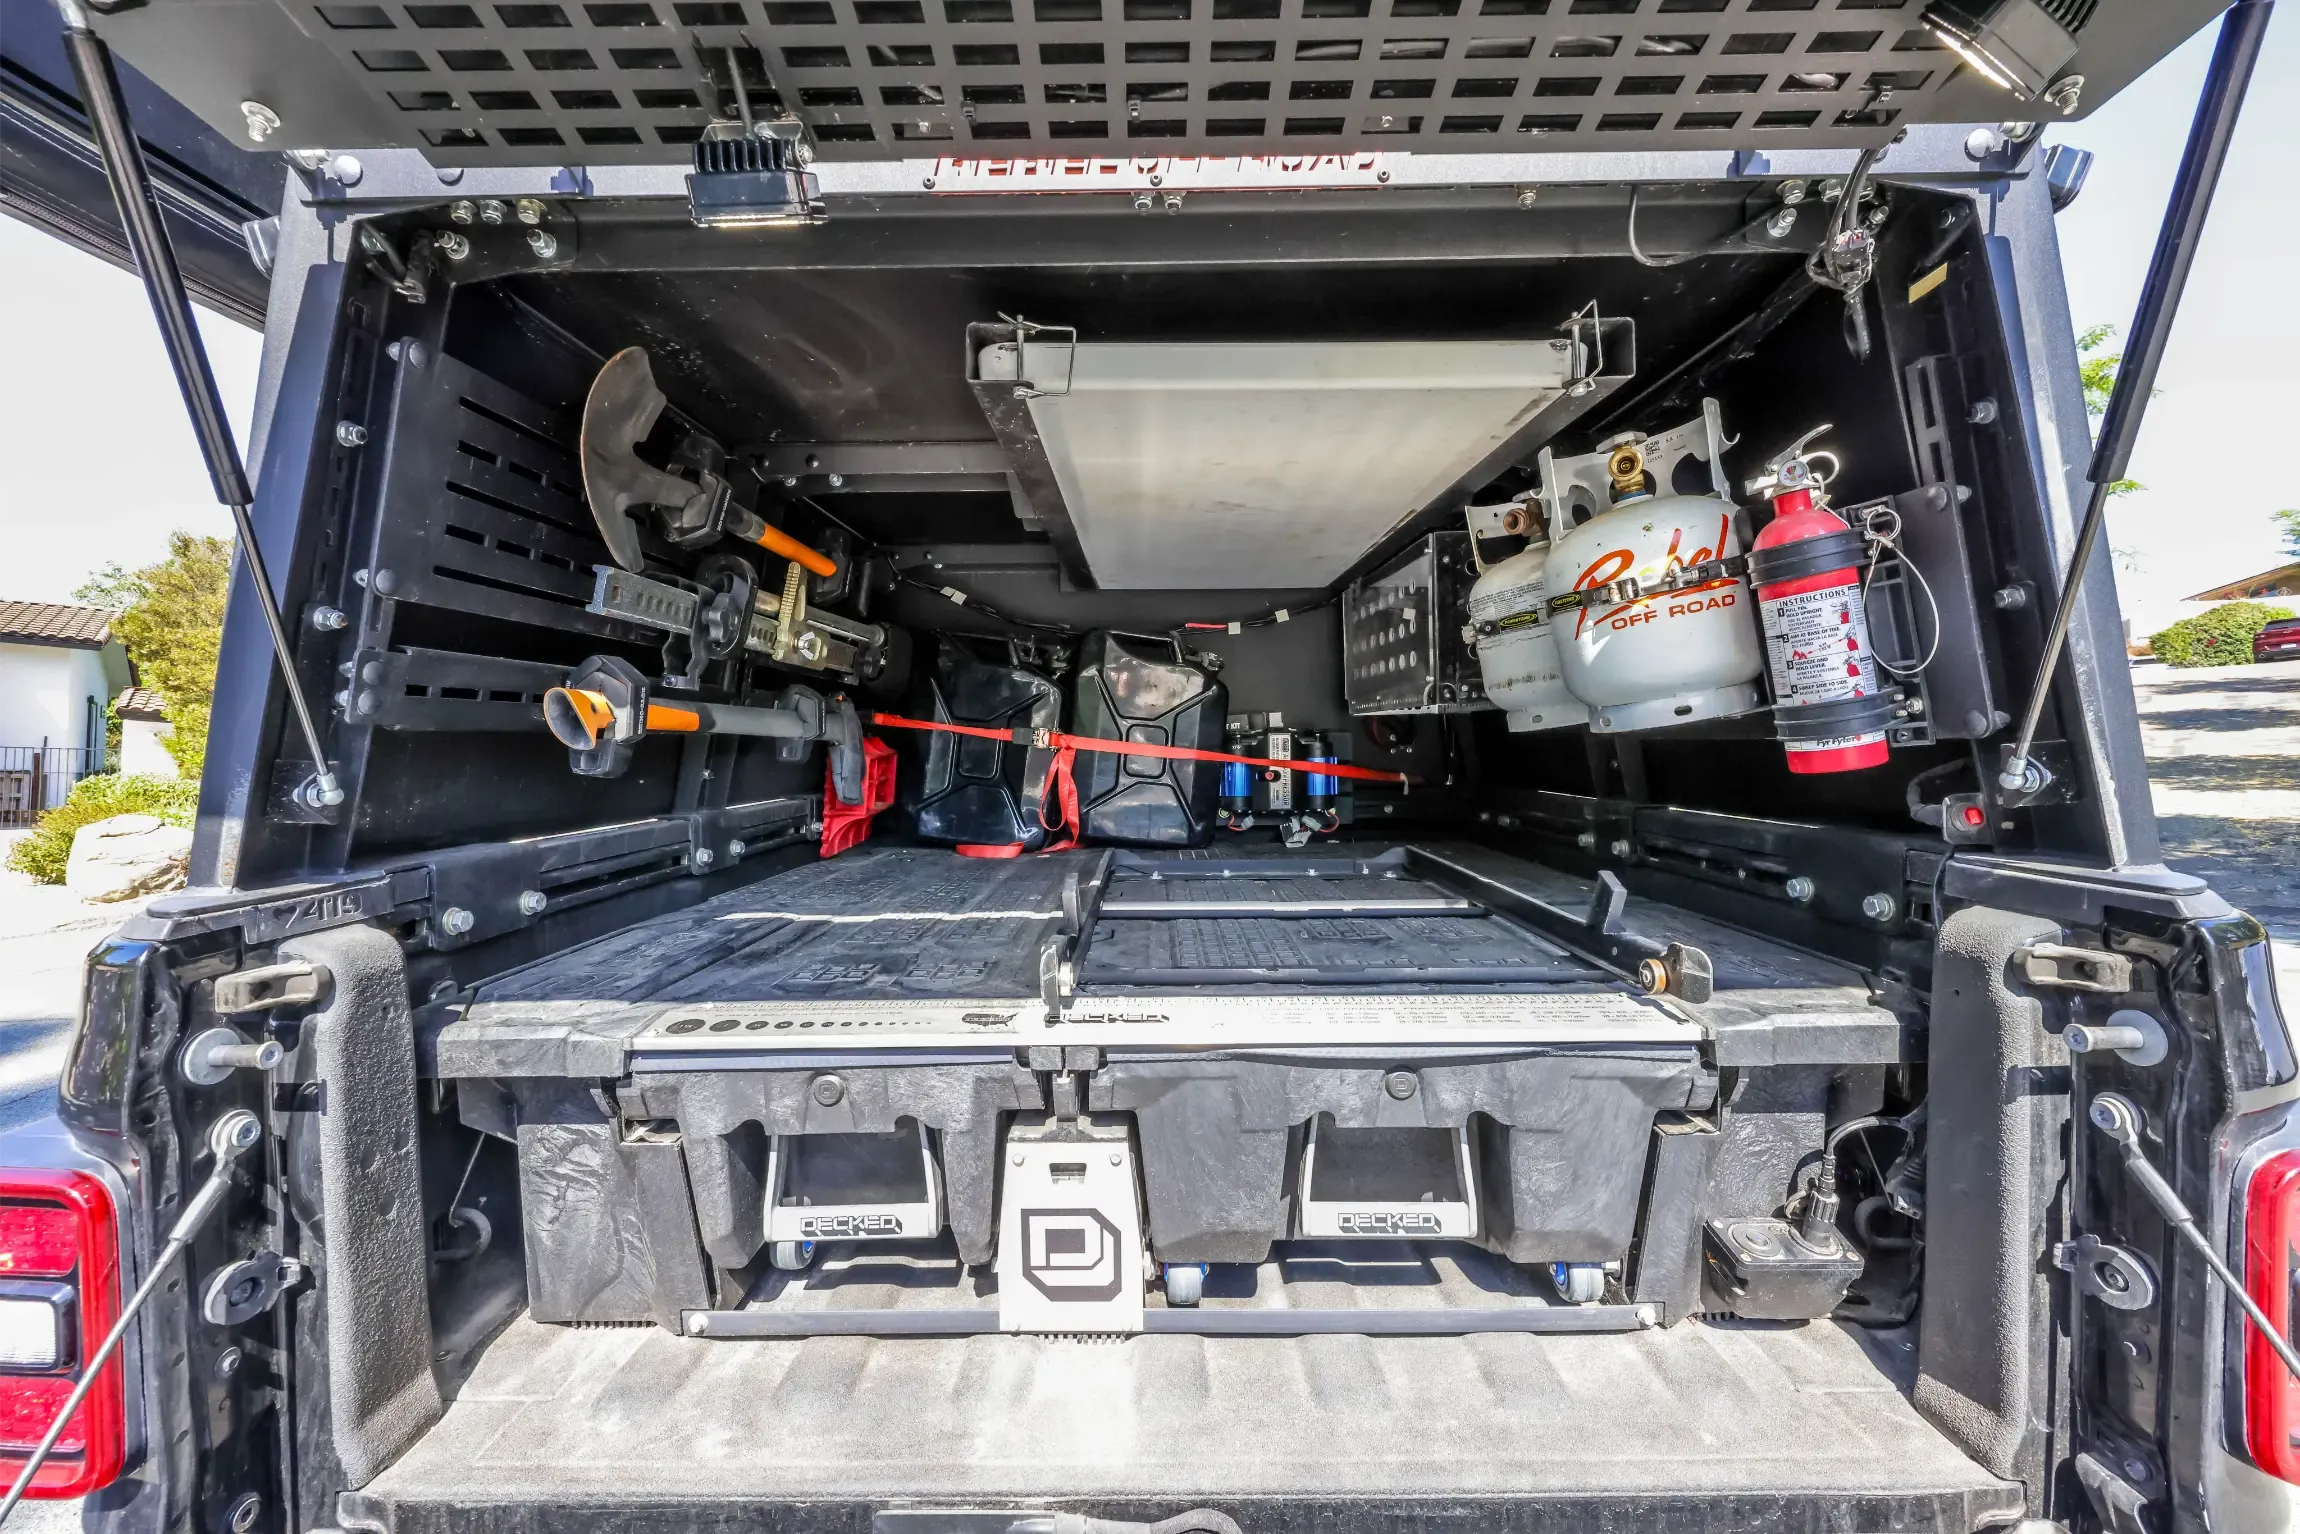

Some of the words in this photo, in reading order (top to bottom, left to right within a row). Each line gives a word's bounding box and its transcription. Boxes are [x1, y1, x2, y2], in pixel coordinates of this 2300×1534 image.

[1779, 589, 1846, 608] INSTRUCTIONS
[1611, 610, 1658, 630] OFF
[1668, 594, 1736, 618] ROAD
[1794, 658, 1816, 666] SQUEEZE
[1816, 739, 1831, 748] Fyr
[1831, 736, 1856, 746] Fyter
[800, 1214, 903, 1238] DECKED
[1337, 1212, 1442, 1234] DECKED
